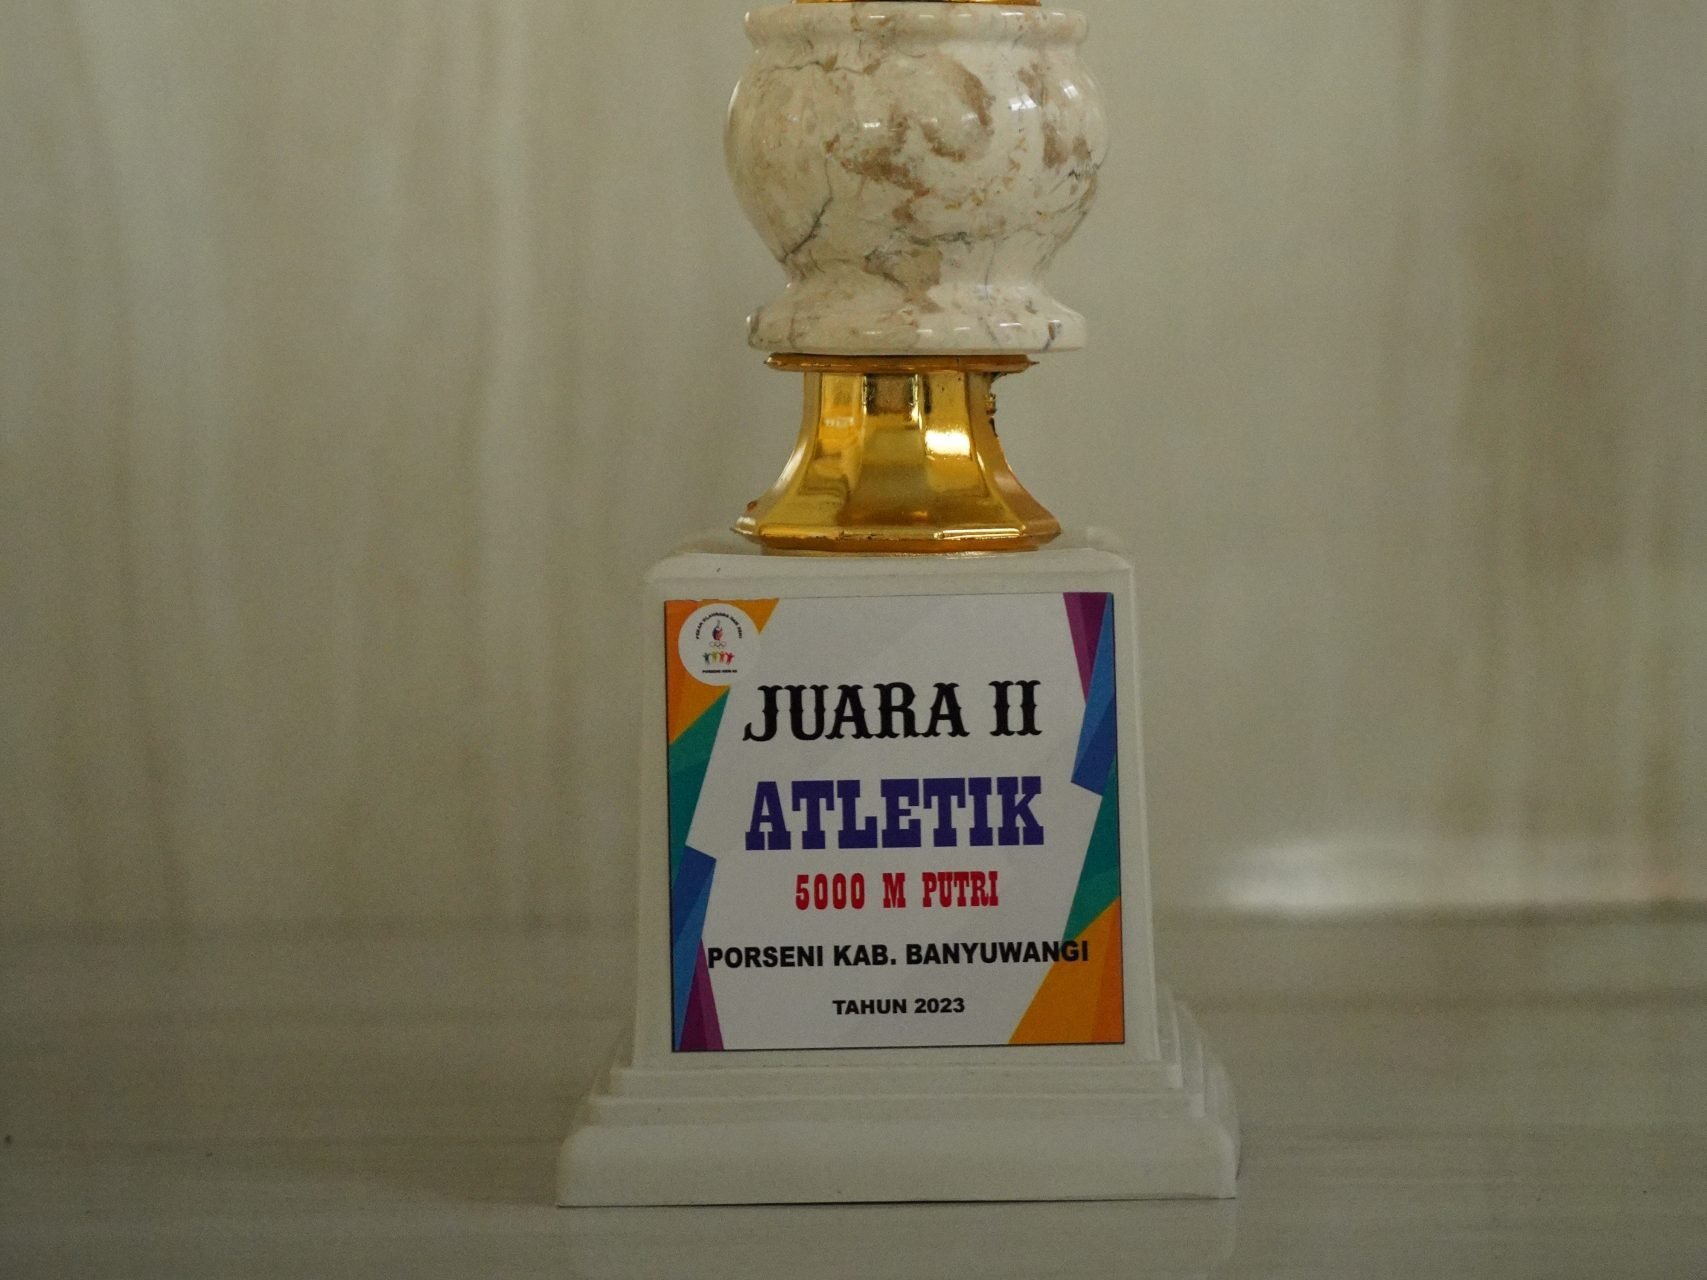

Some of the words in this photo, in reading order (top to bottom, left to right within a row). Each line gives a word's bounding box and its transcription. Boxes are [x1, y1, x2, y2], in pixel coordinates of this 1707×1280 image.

[742, 682, 970, 741] JUARA
[989, 680, 1042, 737] II
[745, 776, 1045, 850] ATLETIK
[795, 874, 866, 910] 5000
[882, 872, 906, 908] M
[922, 871, 999, 907] PUTRI
[708, 945, 823, 969] PORSENI
[833, 944, 897, 968] KAB.
[906, 941, 1089, 966] BANYUWANGI
[832, 999, 908, 1015] TAHUN
[914, 998, 965, 1014] 2023
